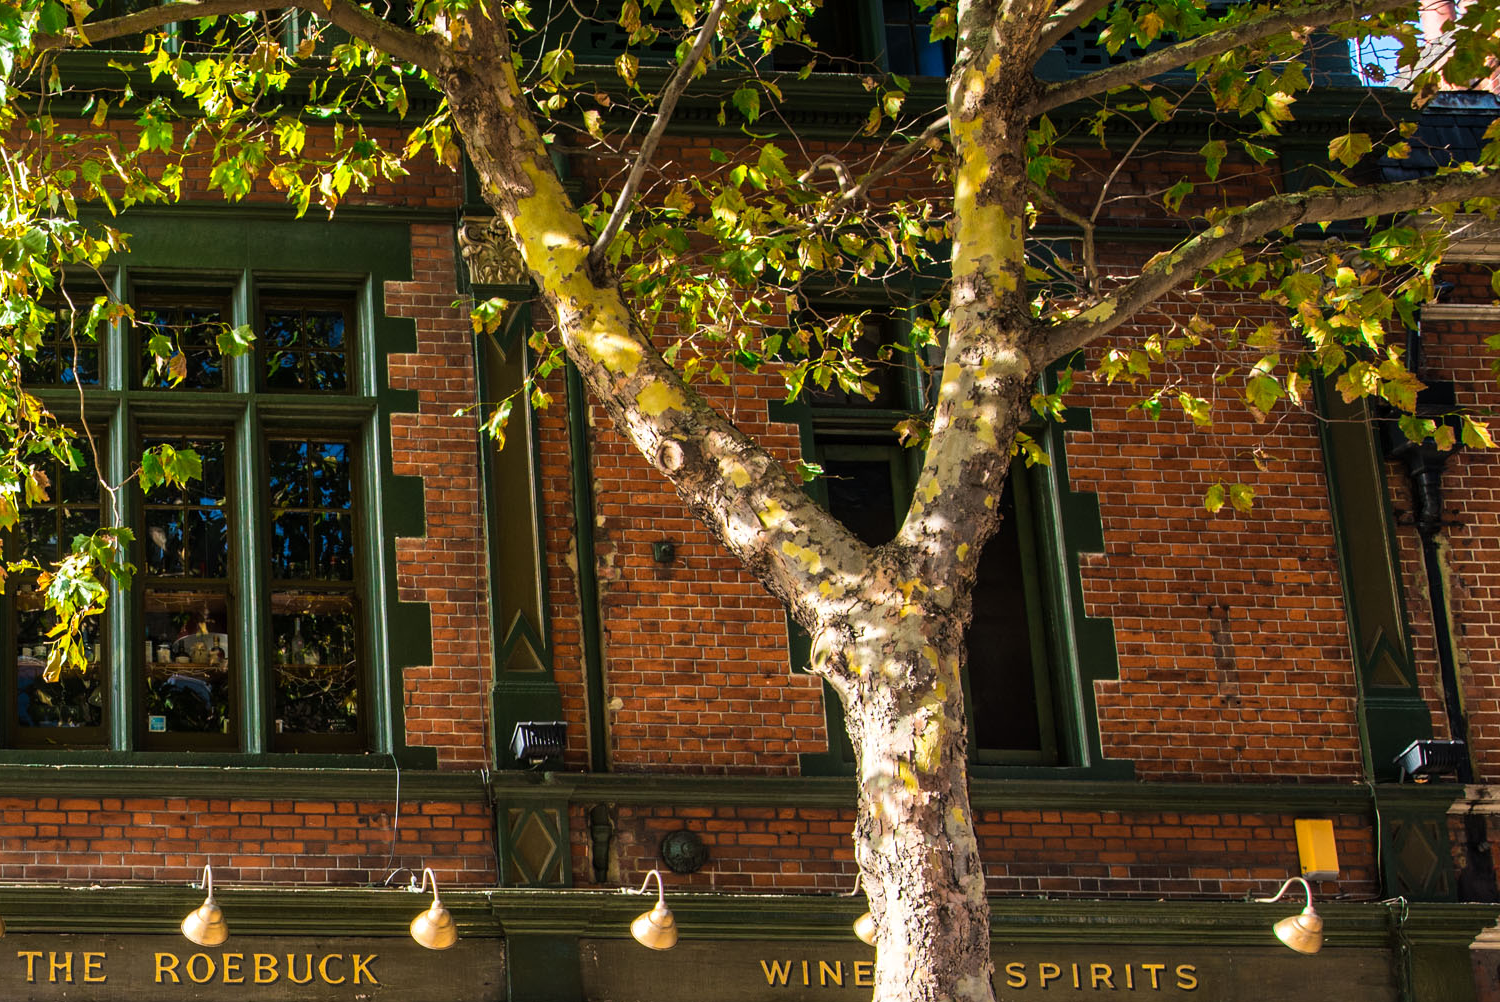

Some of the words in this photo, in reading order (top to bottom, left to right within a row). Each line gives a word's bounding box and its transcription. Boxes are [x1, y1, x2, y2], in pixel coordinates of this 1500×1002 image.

[17, 951, 108, 983] THE
[154, 952, 380, 985] ROEBUCK
[759, 959, 875, 987] WINE
[1006, 962, 1198, 990] SPIRITS
